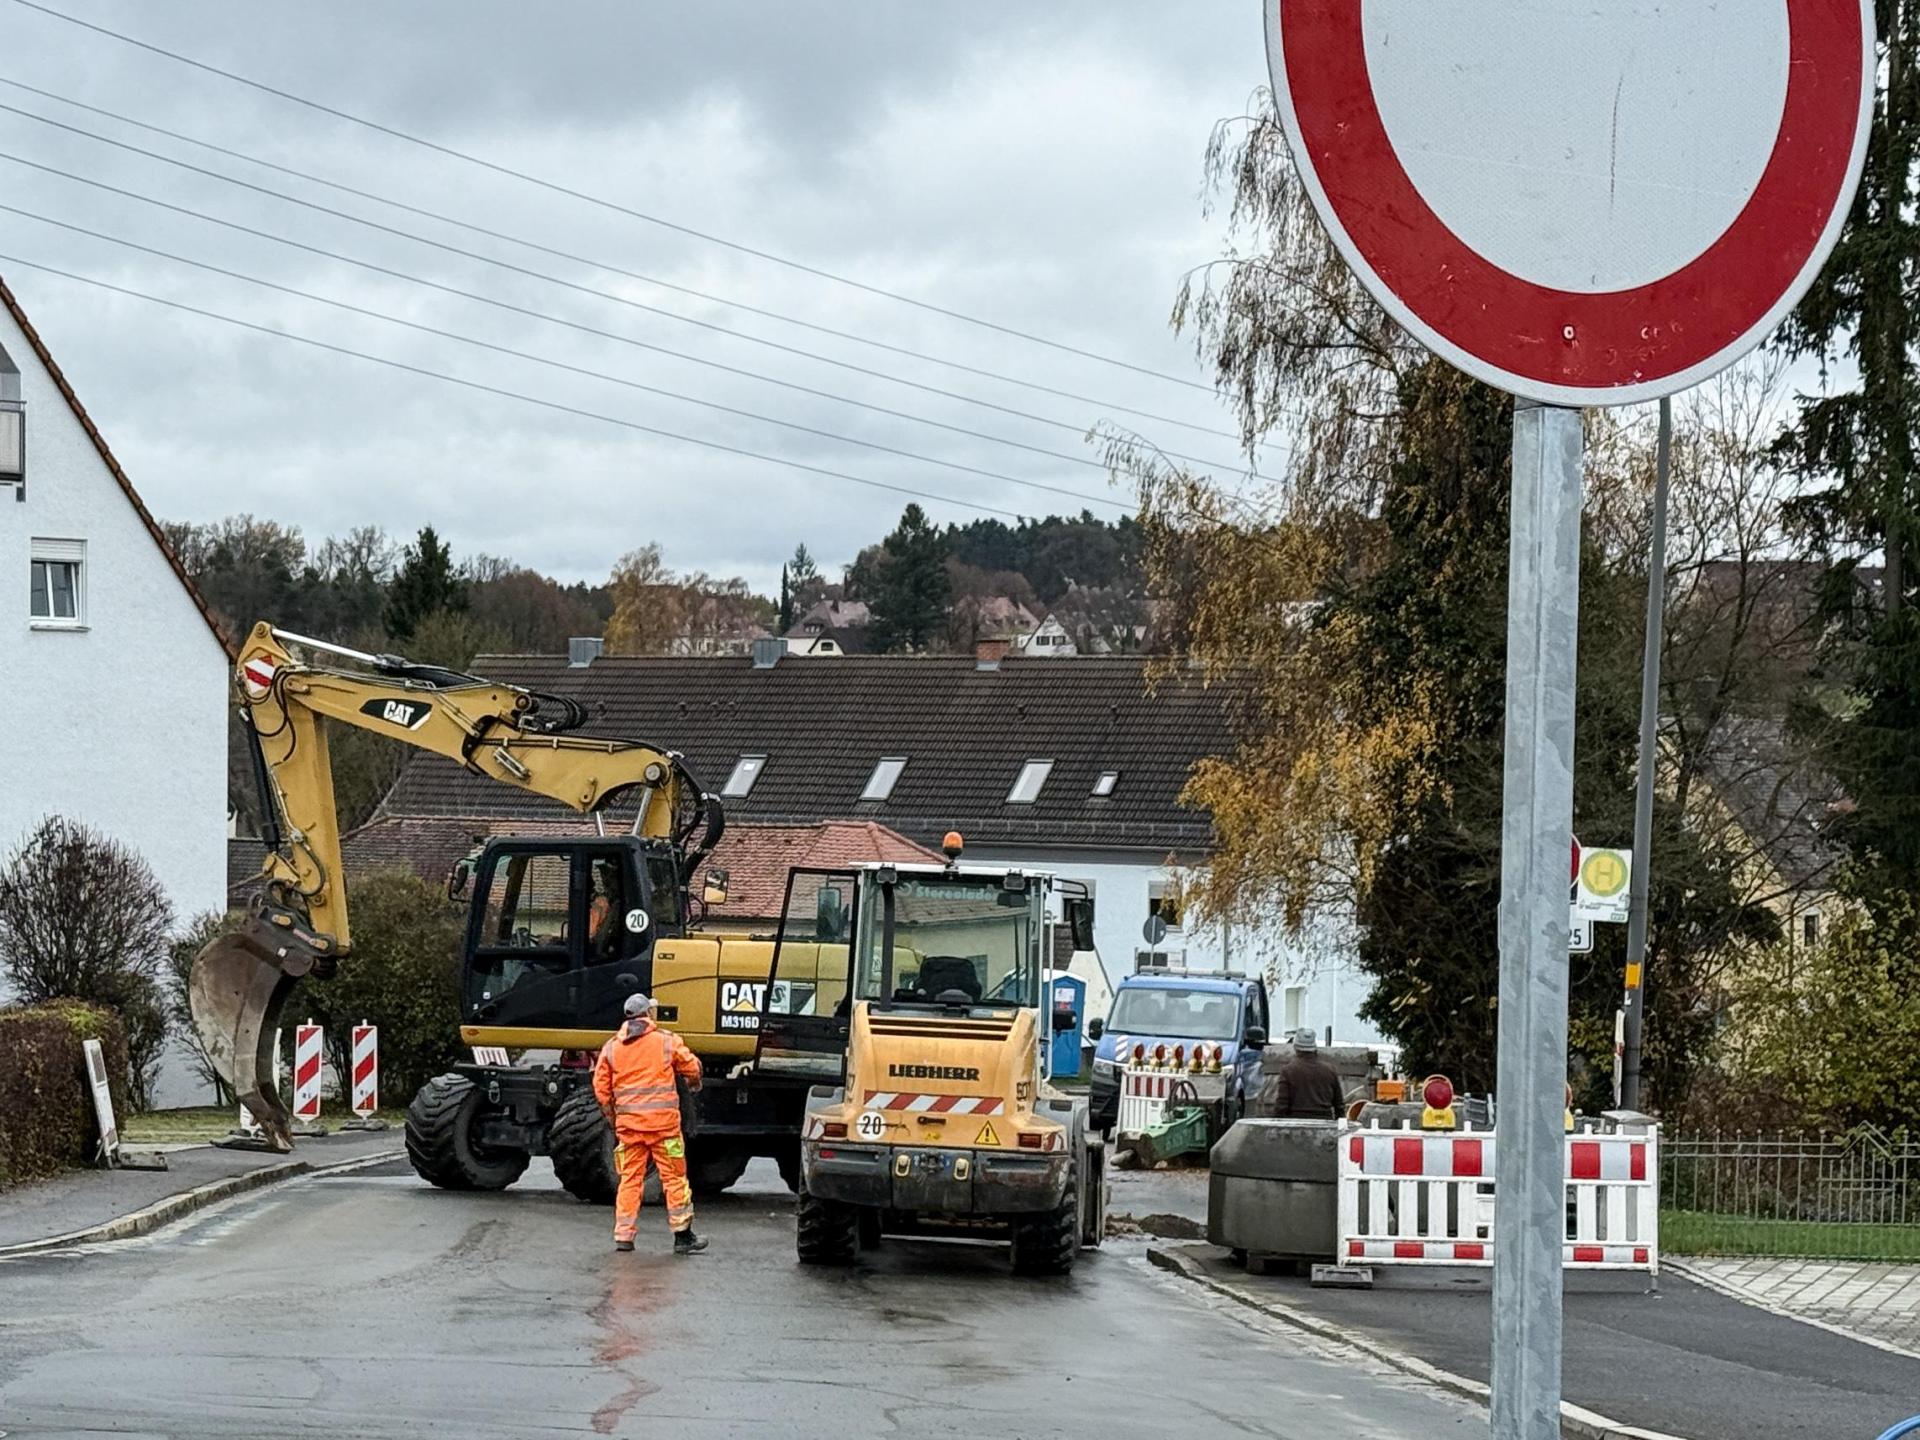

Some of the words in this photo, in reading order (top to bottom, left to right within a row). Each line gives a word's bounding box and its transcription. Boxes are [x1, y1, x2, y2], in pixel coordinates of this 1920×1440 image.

[383, 700, 415, 726] CAT
[1595, 860, 1615, 886] H
[630, 913, 645, 929] 20
[721, 982, 768, 1013] CAT
[721, 1015, 760, 1029] M316D
[889, 1064, 980, 1081] LIEBHERR
[862, 1115, 882, 1135] 20
